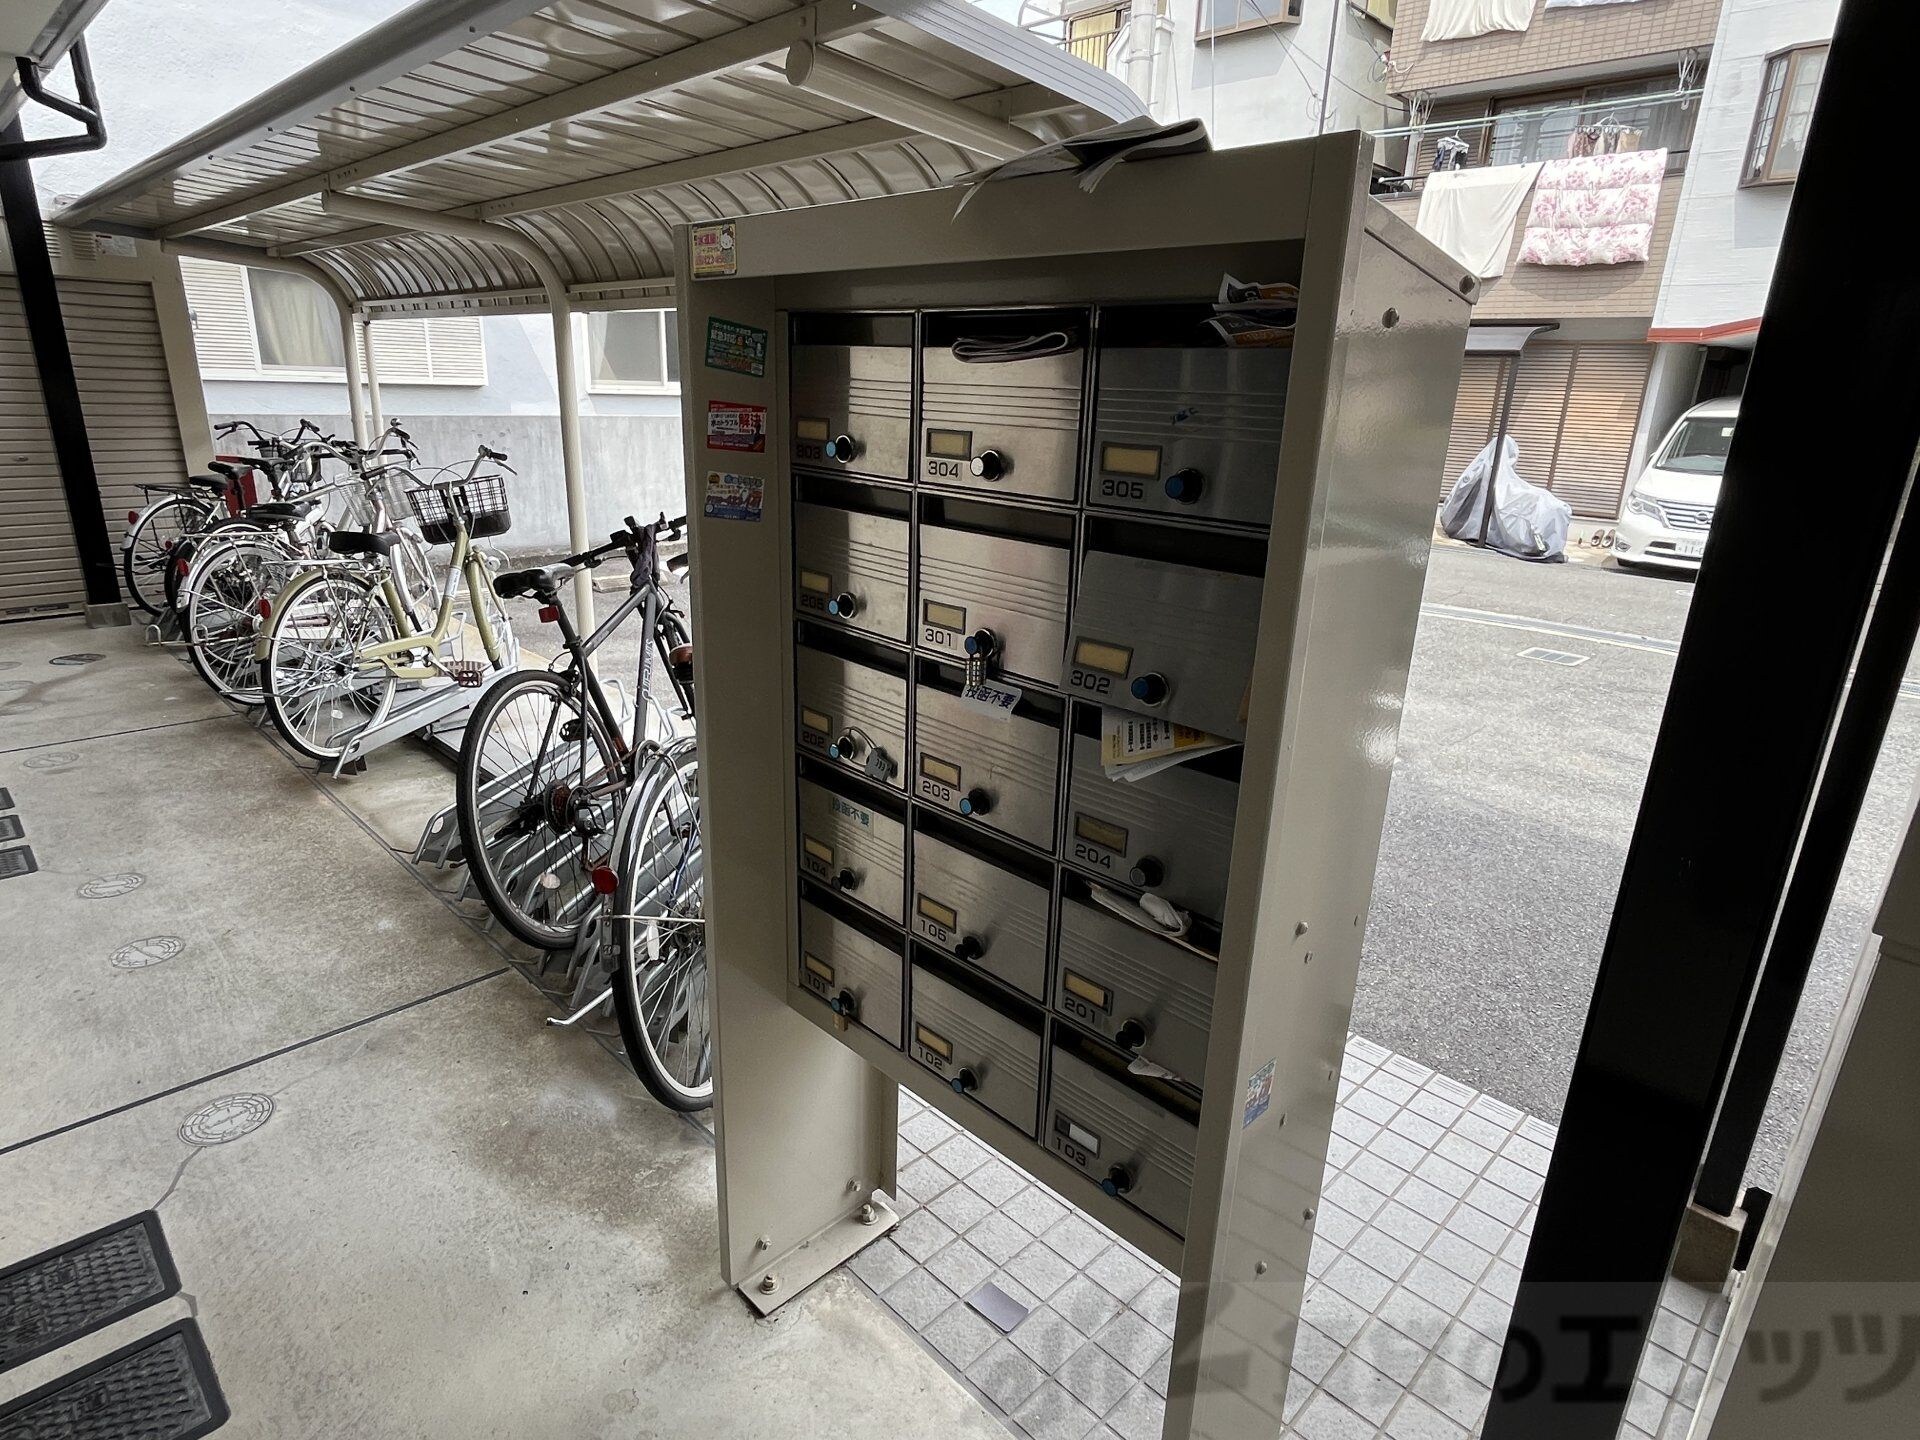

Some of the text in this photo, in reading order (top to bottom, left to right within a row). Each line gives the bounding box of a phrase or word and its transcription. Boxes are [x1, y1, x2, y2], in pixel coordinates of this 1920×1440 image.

[796, 443, 822, 461] 303
[928, 460, 960, 479] 304
[1102, 478, 1145, 500] 305
[801, 590, 825, 610] 205
[925, 628, 953, 647] 301
[1070, 669, 1112, 694] 302
[964, 686, 1016, 709] 投函不要
[802, 730, 825, 749] 202
[922, 780, 951, 802] 203
[805, 857, 827, 877] 104
[1075, 843, 1112, 869] 204
[806, 973, 826, 993] 101
[1064, 996, 1098, 1023] 201
[918, 1046, 943, 1069] 102
[1056, 1136, 1087, 1167] 103
